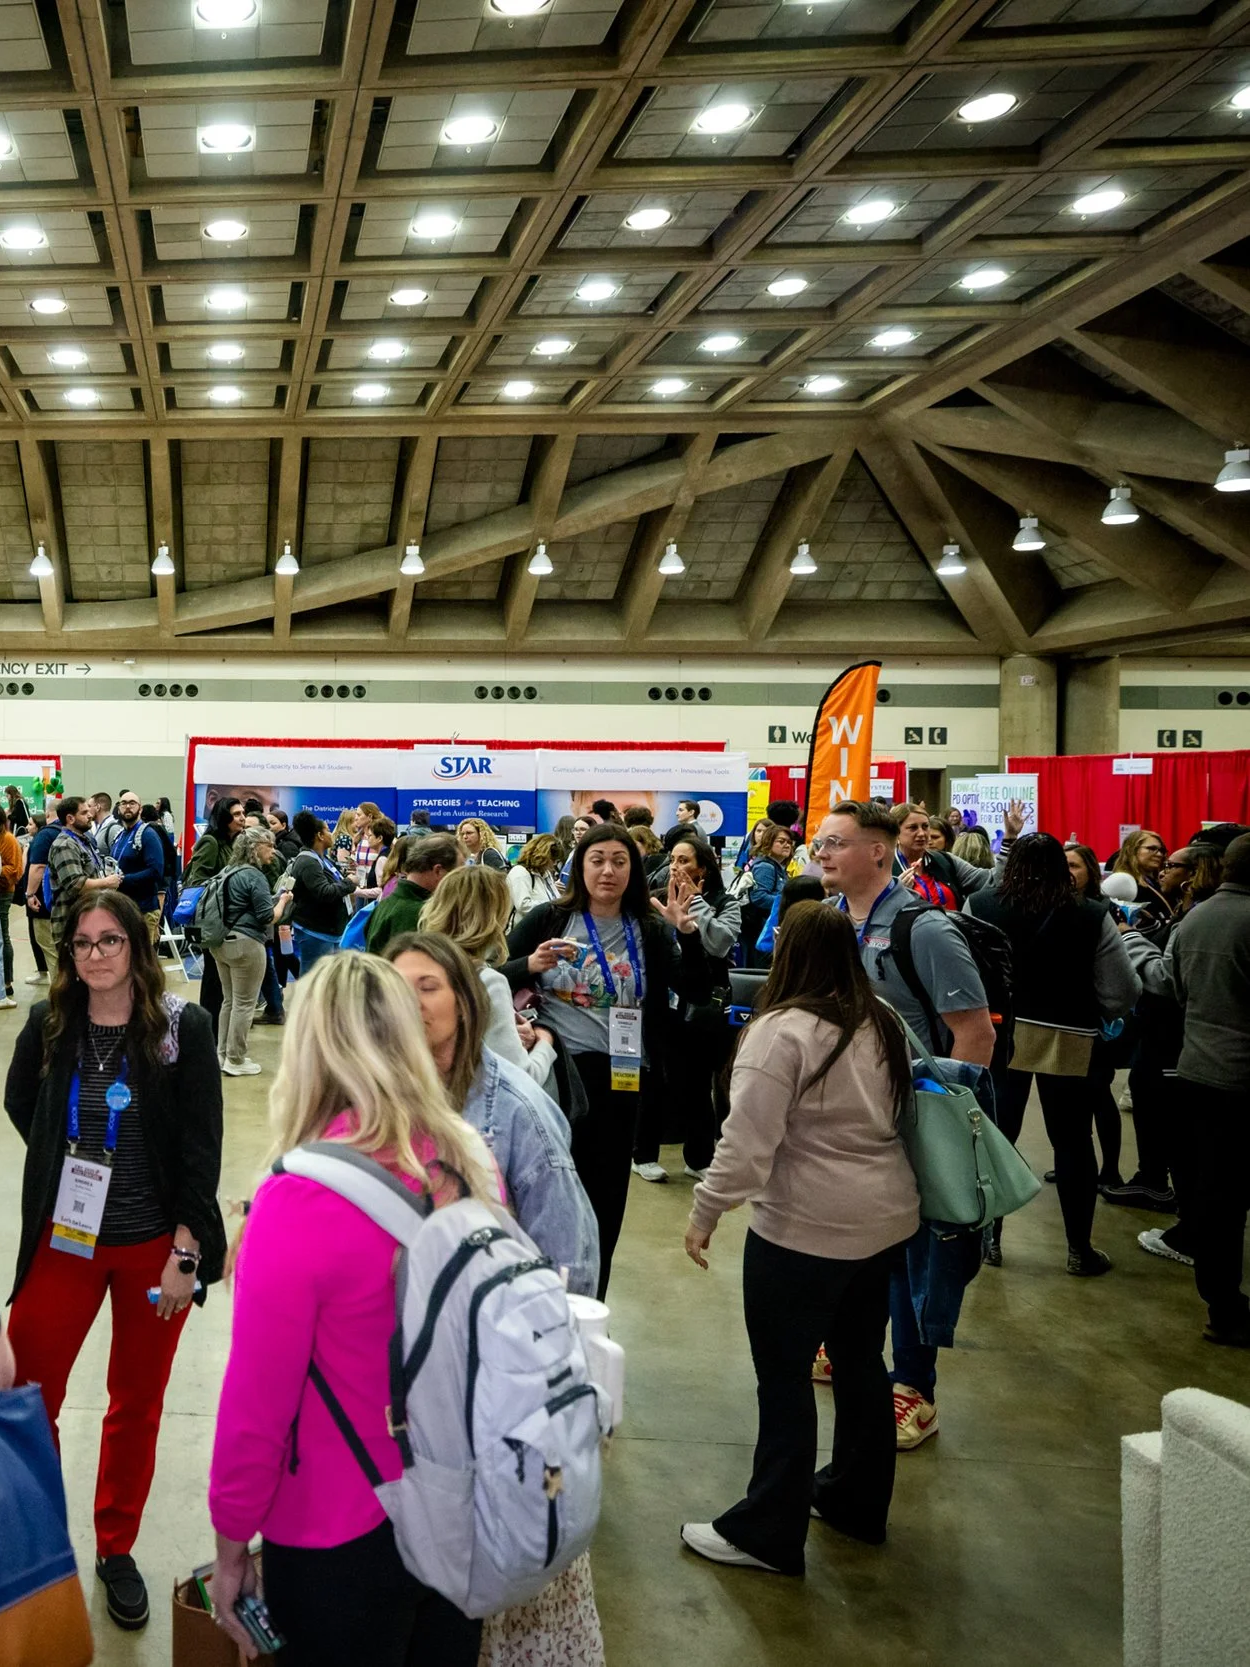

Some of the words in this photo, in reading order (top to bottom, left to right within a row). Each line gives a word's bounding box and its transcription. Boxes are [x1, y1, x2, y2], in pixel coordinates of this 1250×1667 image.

[35, 662, 69, 675] EXIT
[792, 731, 812, 744] Wo
[241, 762, 265, 770] Building
[266, 763, 290, 771] Capacity
[440, 756, 493, 774] STAR
[631, 767, 672, 775] Development
[981, 786, 1000, 800] FREE
[1001, 786, 1035, 801] ONLINE
[413, 799, 461, 807] STRATEGIES
[477, 799, 521, 808] TEACHING
[980, 802, 1035, 813] RESOUES
